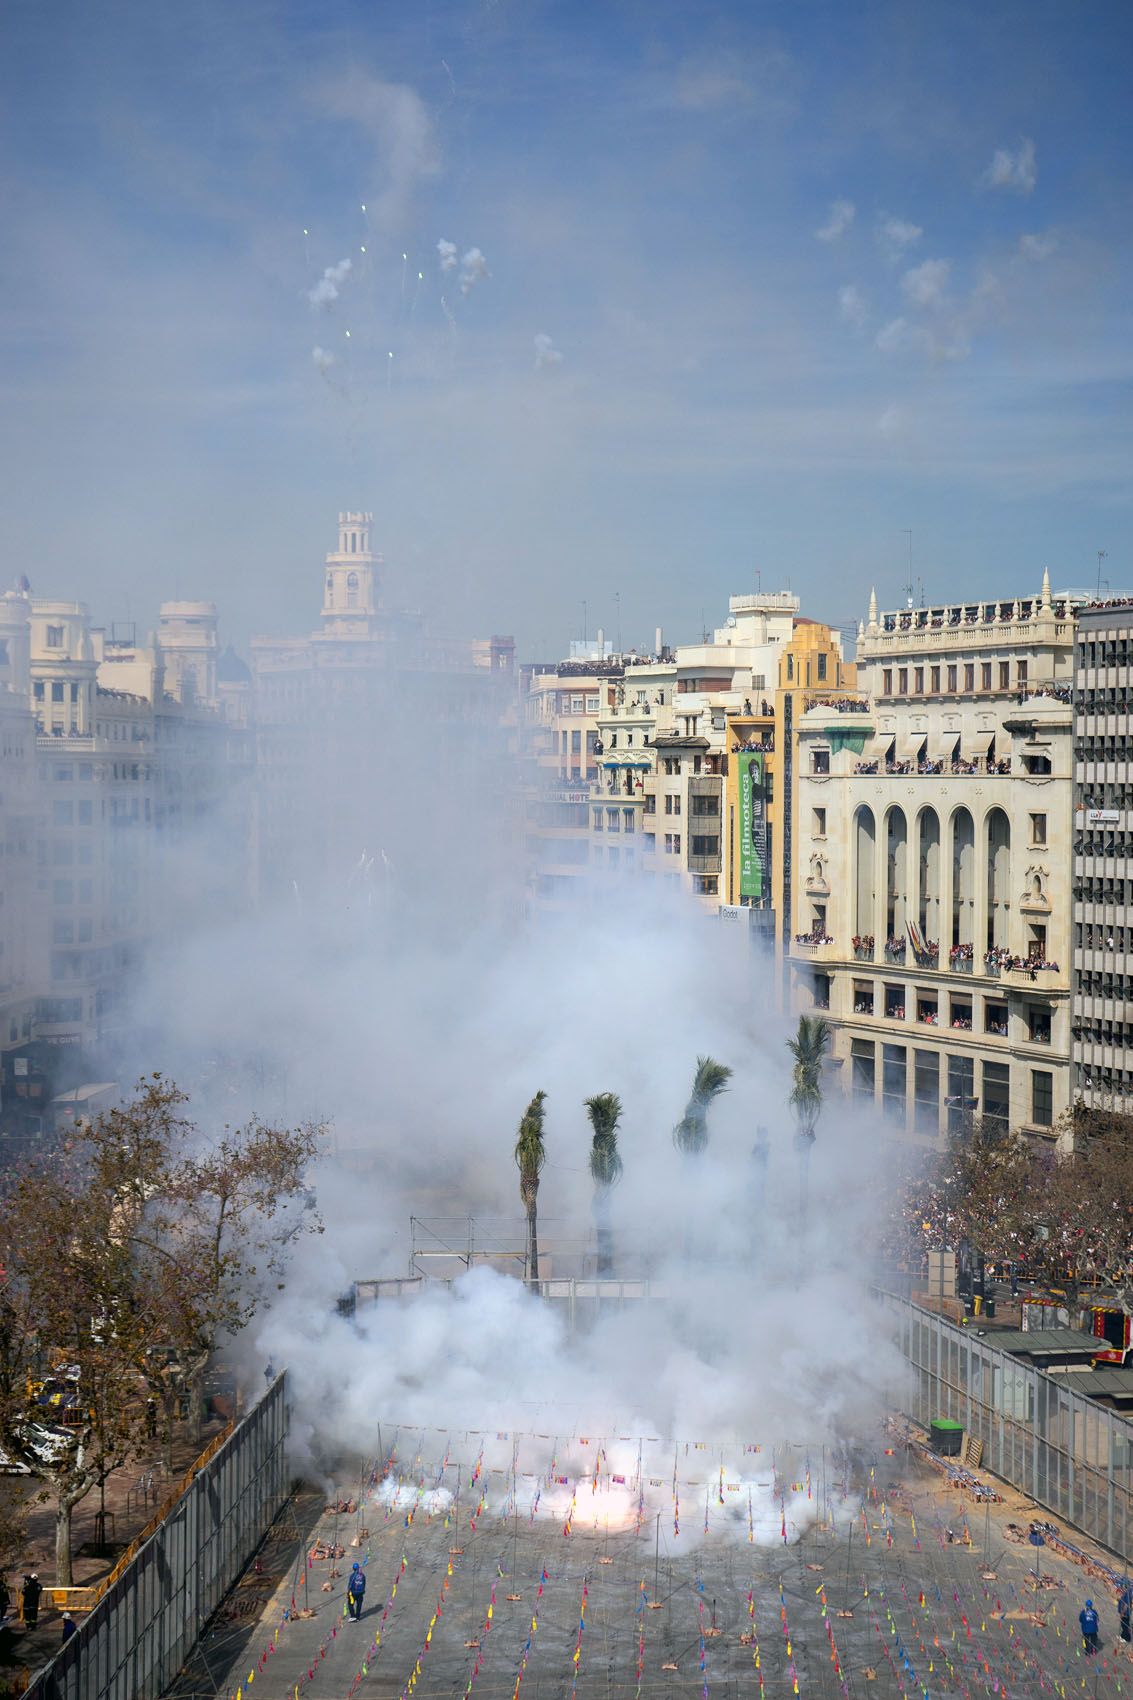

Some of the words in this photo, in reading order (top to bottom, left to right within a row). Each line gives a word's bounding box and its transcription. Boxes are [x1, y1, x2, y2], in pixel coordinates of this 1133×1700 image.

[569, 793, 590, 802] HOTE
[742, 774, 751, 856] filmoteca
[742, 860, 751, 876] la
